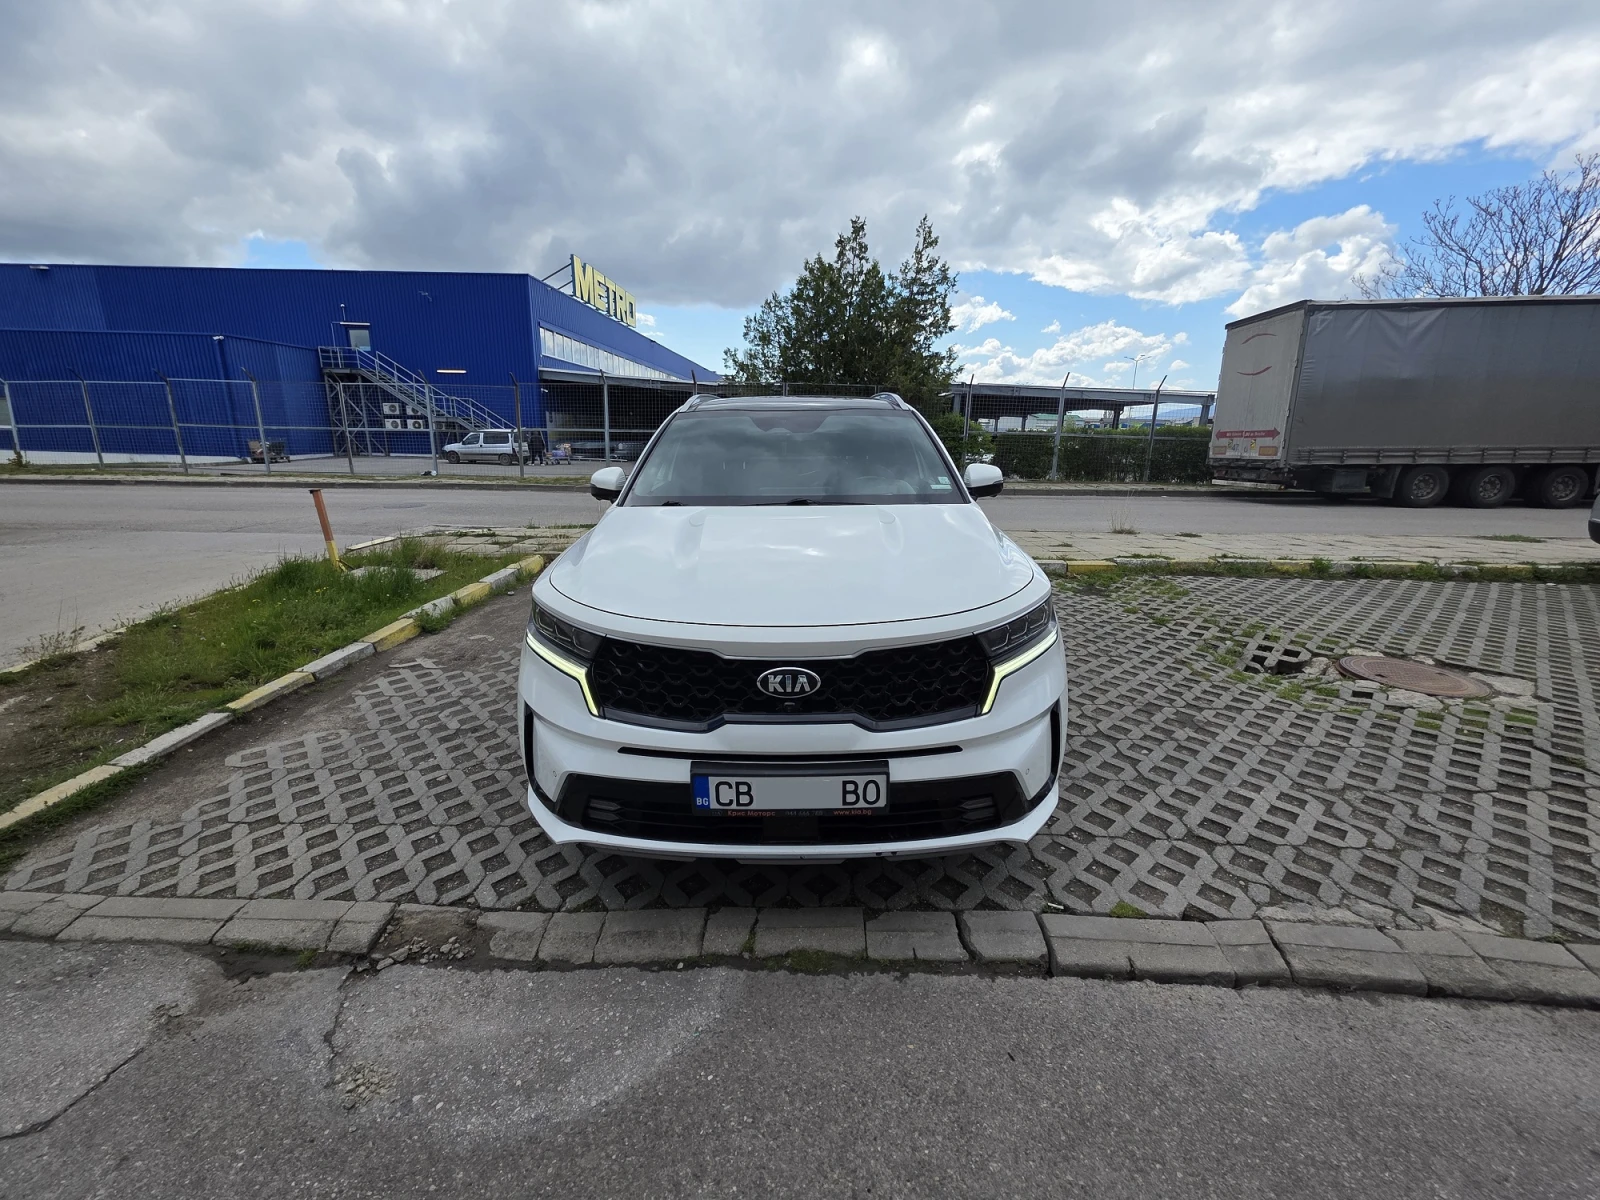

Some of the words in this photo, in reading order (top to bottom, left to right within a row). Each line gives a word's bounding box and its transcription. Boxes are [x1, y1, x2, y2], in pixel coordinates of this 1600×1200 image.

[571, 254, 637, 328] METRO
[767, 674, 811, 693] KIA
[696, 797, 709, 806] BG
[714, 781, 755, 807] CB
[833, 808, 872, 816] www.kia.bg
